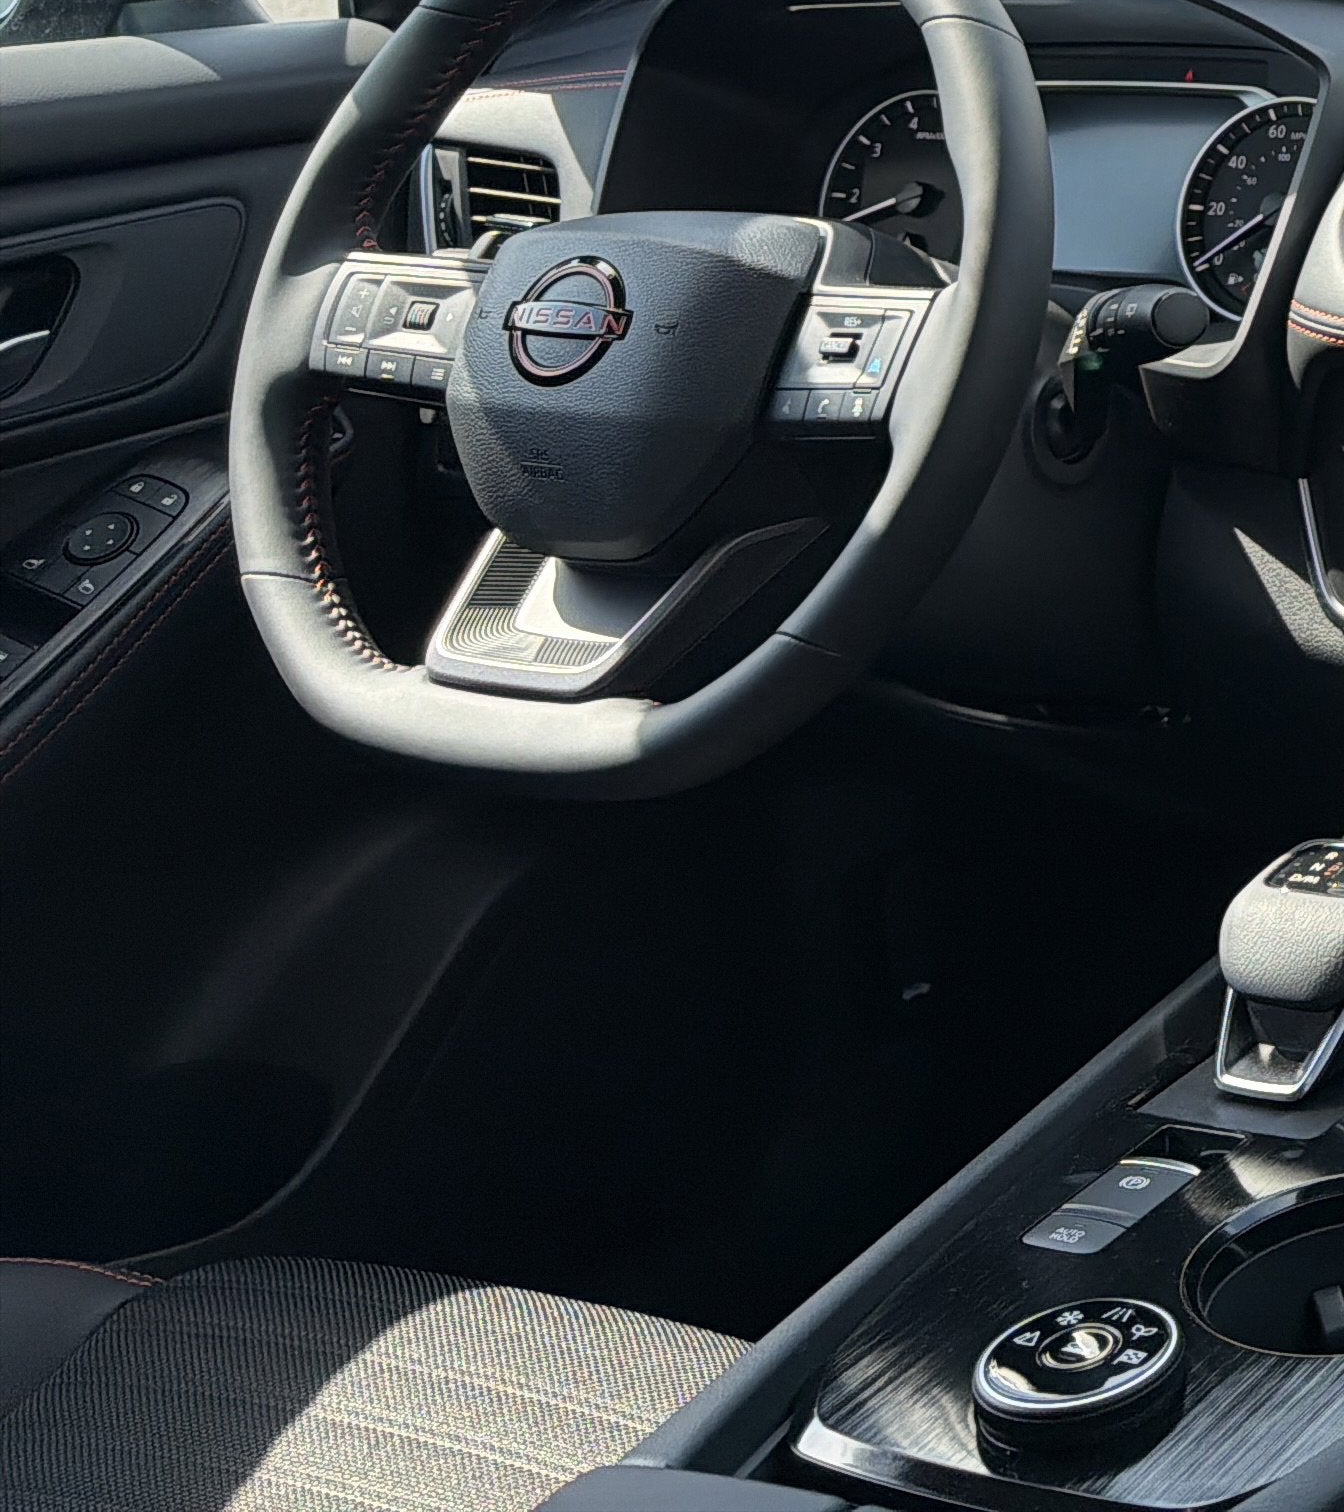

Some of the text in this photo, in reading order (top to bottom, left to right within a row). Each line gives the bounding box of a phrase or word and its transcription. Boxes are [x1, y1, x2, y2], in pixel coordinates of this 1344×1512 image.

[908, 117, 918, 130] 4
[1268, 125, 1286, 139] 60
[873, 143, 882, 158] 3
[1228, 155, 1246, 170] 40
[850, 188, 860, 203] 2
[1207, 201, 1225, 216] 20
[511, 303, 628, 337] NISSAN
[1309, 862, 1326, 871] N
[1055, 1227, 1086, 1238] AUTO
